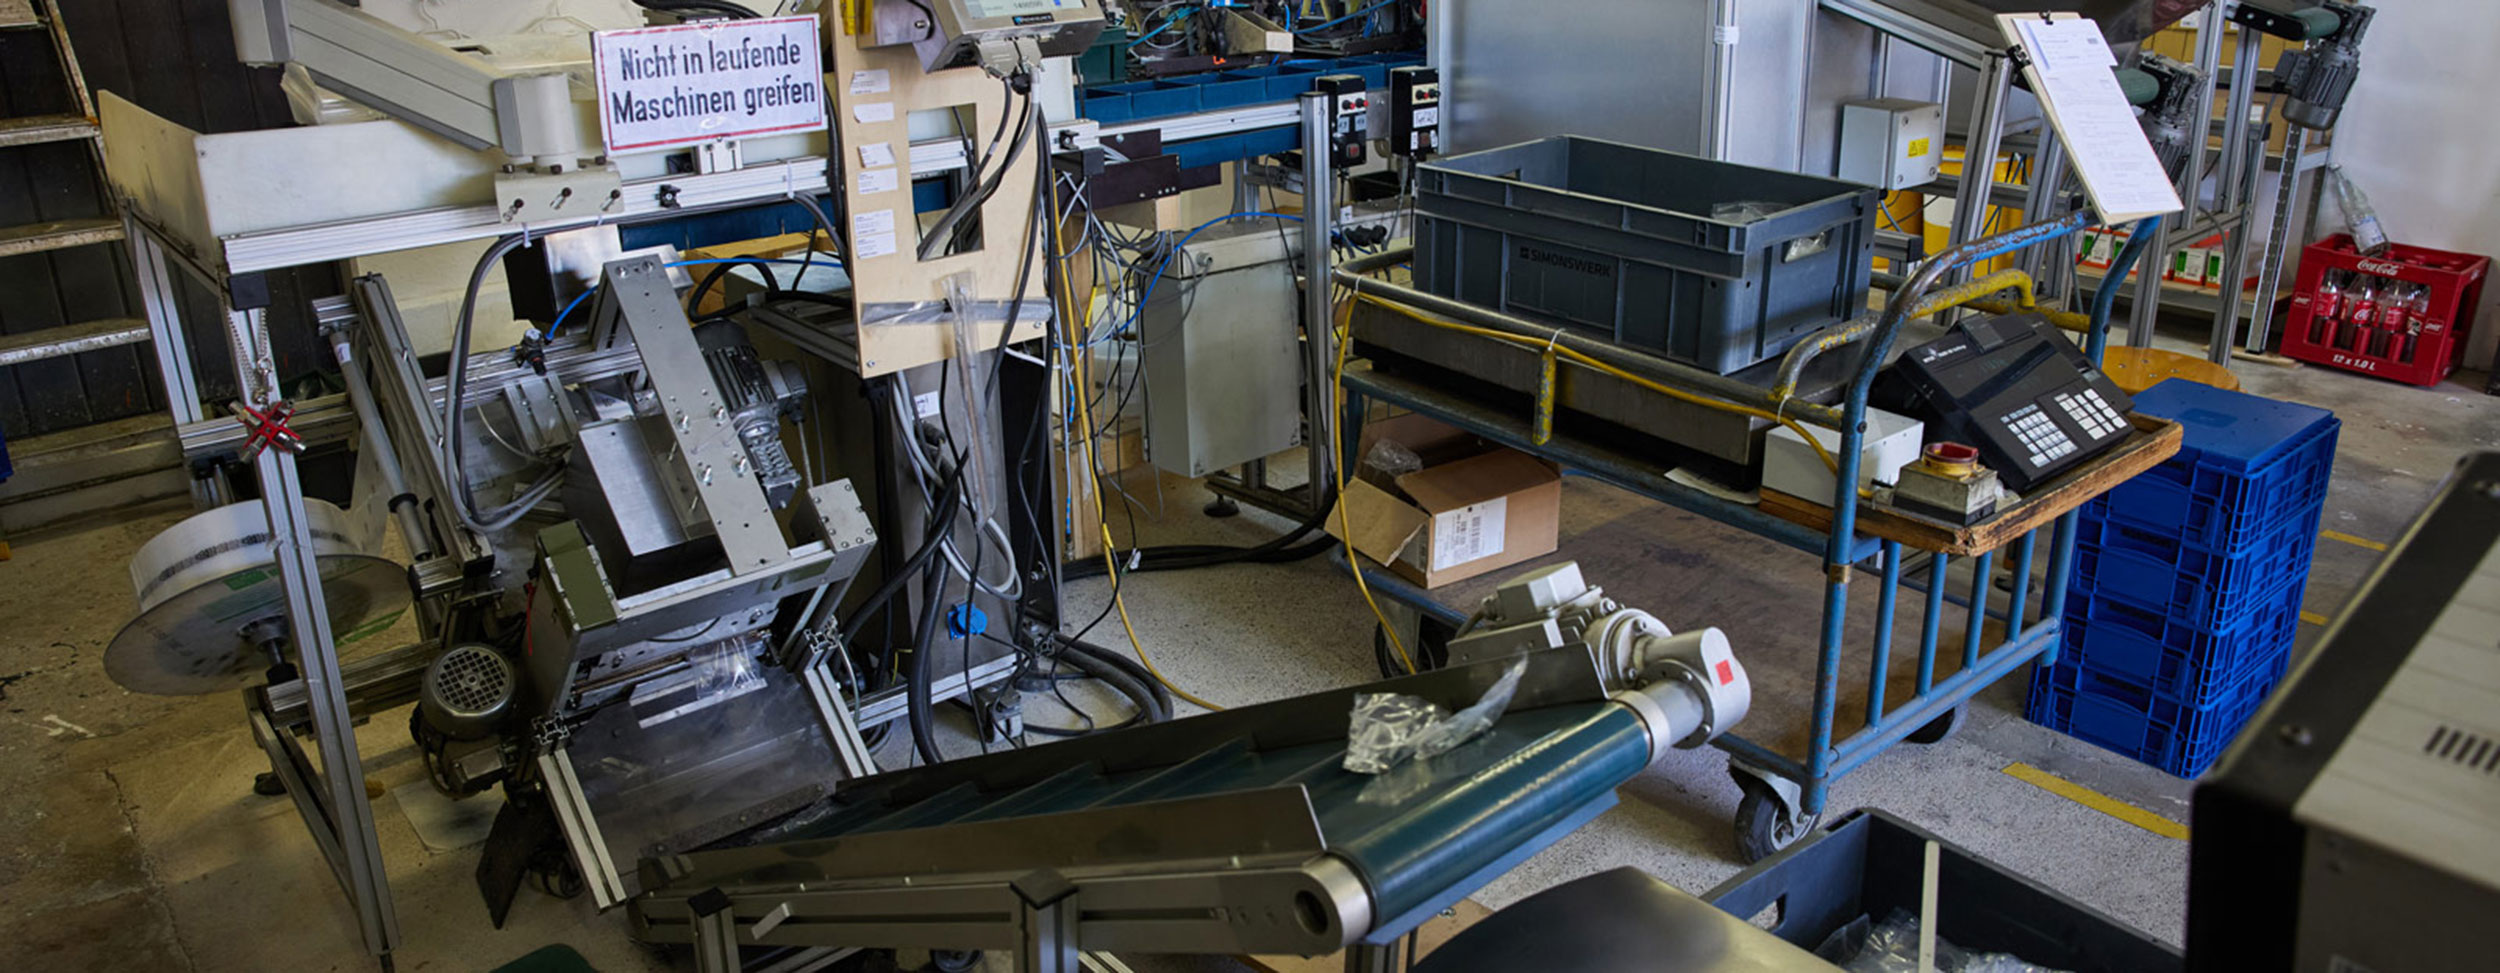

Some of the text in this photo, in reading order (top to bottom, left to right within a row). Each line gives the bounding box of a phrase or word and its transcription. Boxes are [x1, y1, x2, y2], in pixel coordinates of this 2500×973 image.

[620, 34, 801, 81] Nicht in laufende
[612, 86, 736, 124] Maschinen
[744, 74, 815, 116] greifen
[1530, 249, 1611, 278] SIMONSWERK
[2332, 354, 2344, 364] 12
